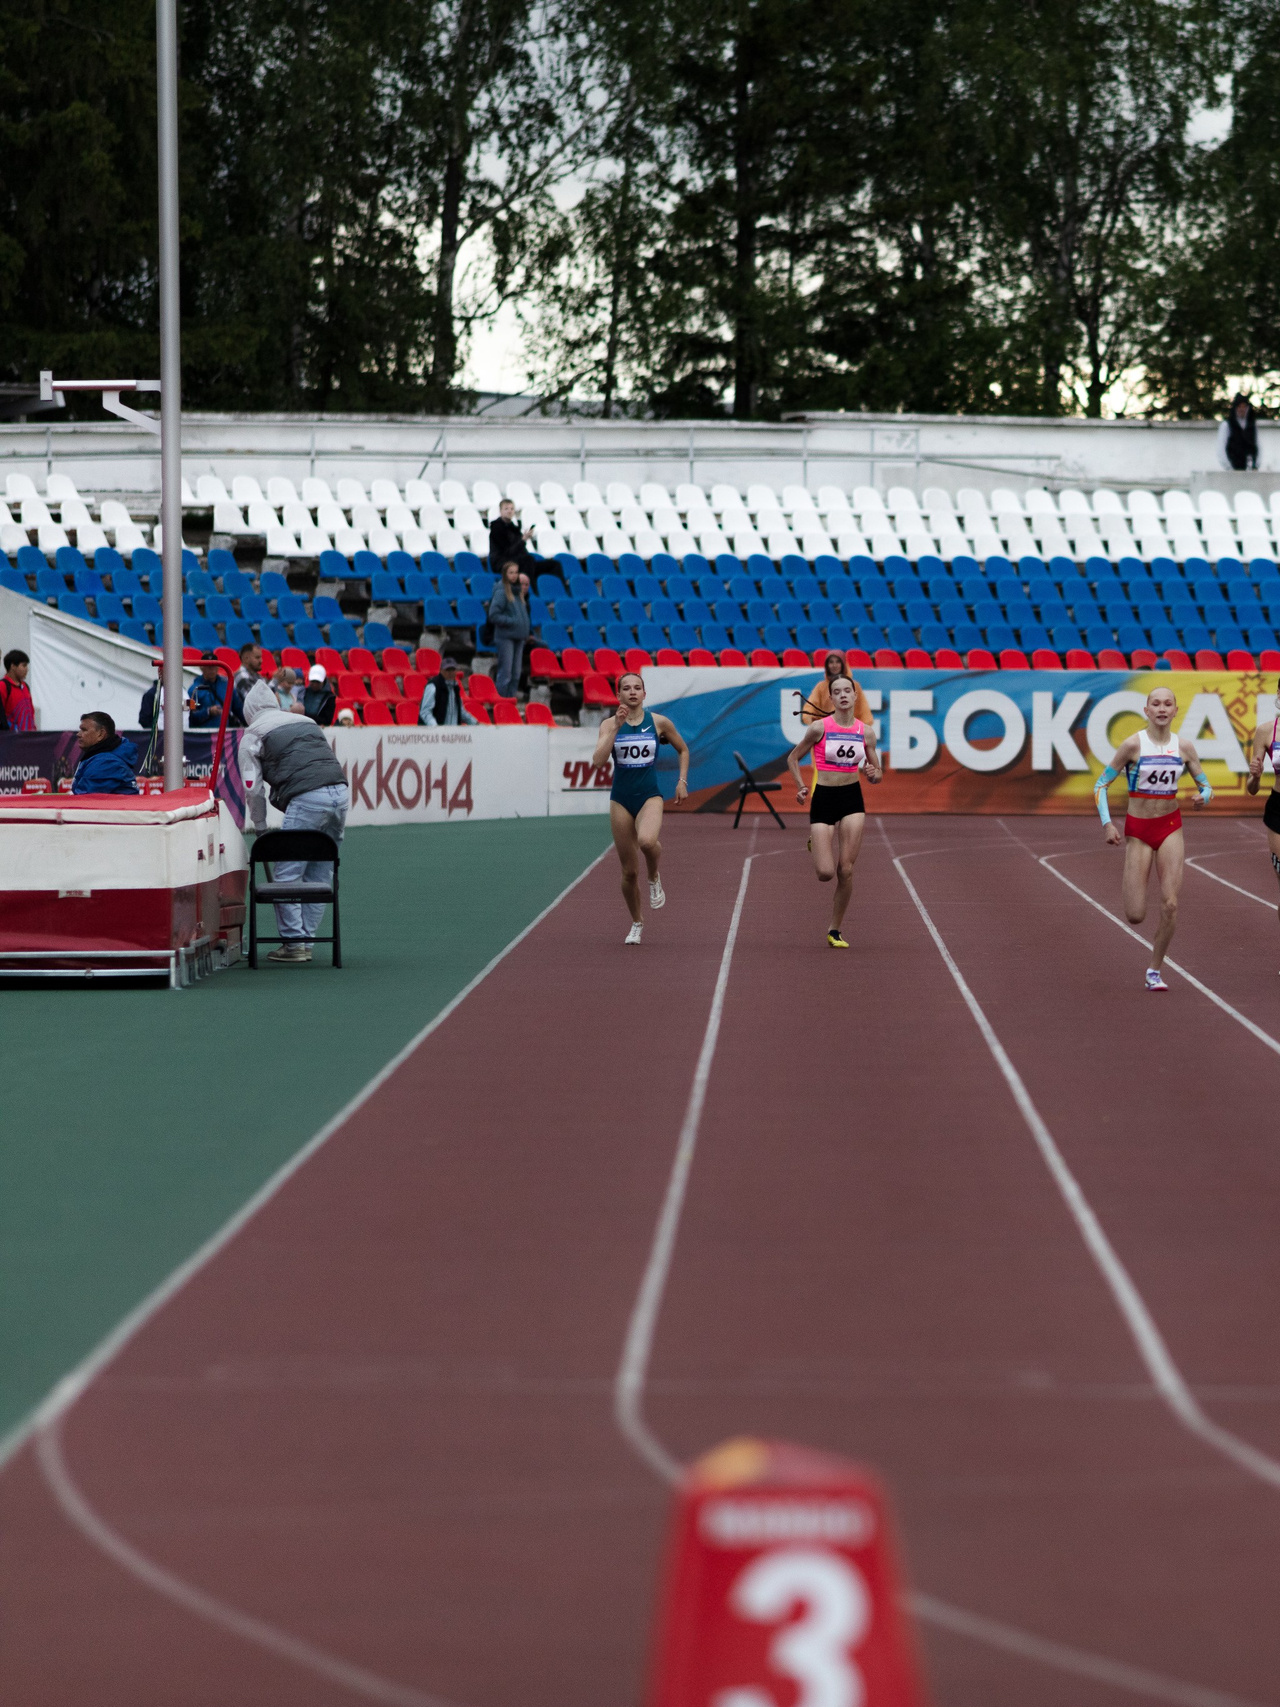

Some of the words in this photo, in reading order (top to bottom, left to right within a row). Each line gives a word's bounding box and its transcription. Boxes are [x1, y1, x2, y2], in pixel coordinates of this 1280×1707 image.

[388, 734, 439, 745] КОНДИТЕРСКАЯ
[441, 734, 473, 744] ФАБРИКА
[620, 744, 650, 760] 706
[836, 744, 856, 759] 66
[331, 736, 473, 817] ККОНД
[1147, 769, 1176, 785] 641
[729, 1548, 874, 1707] 3
